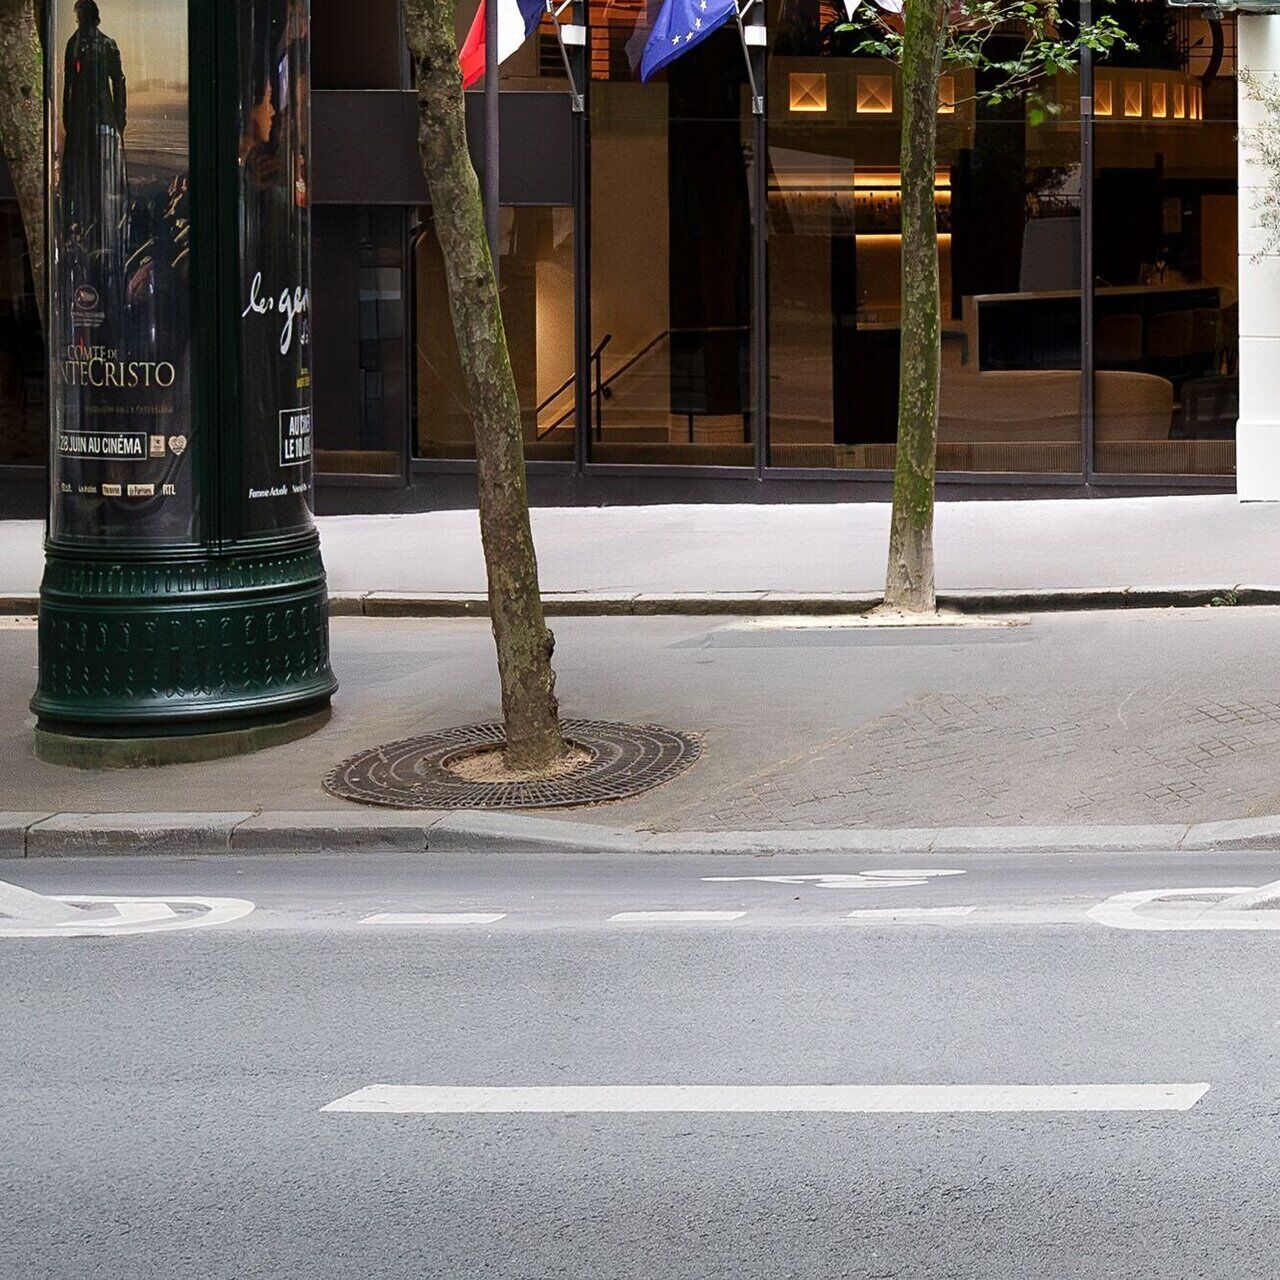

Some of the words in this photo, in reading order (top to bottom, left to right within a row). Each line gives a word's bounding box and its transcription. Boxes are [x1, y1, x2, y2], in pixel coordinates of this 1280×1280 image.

[69, 435, 87, 453] JUIN
[88, 438, 101, 454] AU
[101, 434, 142, 455] CINÉMA
[162, 483, 176, 495] RTL
